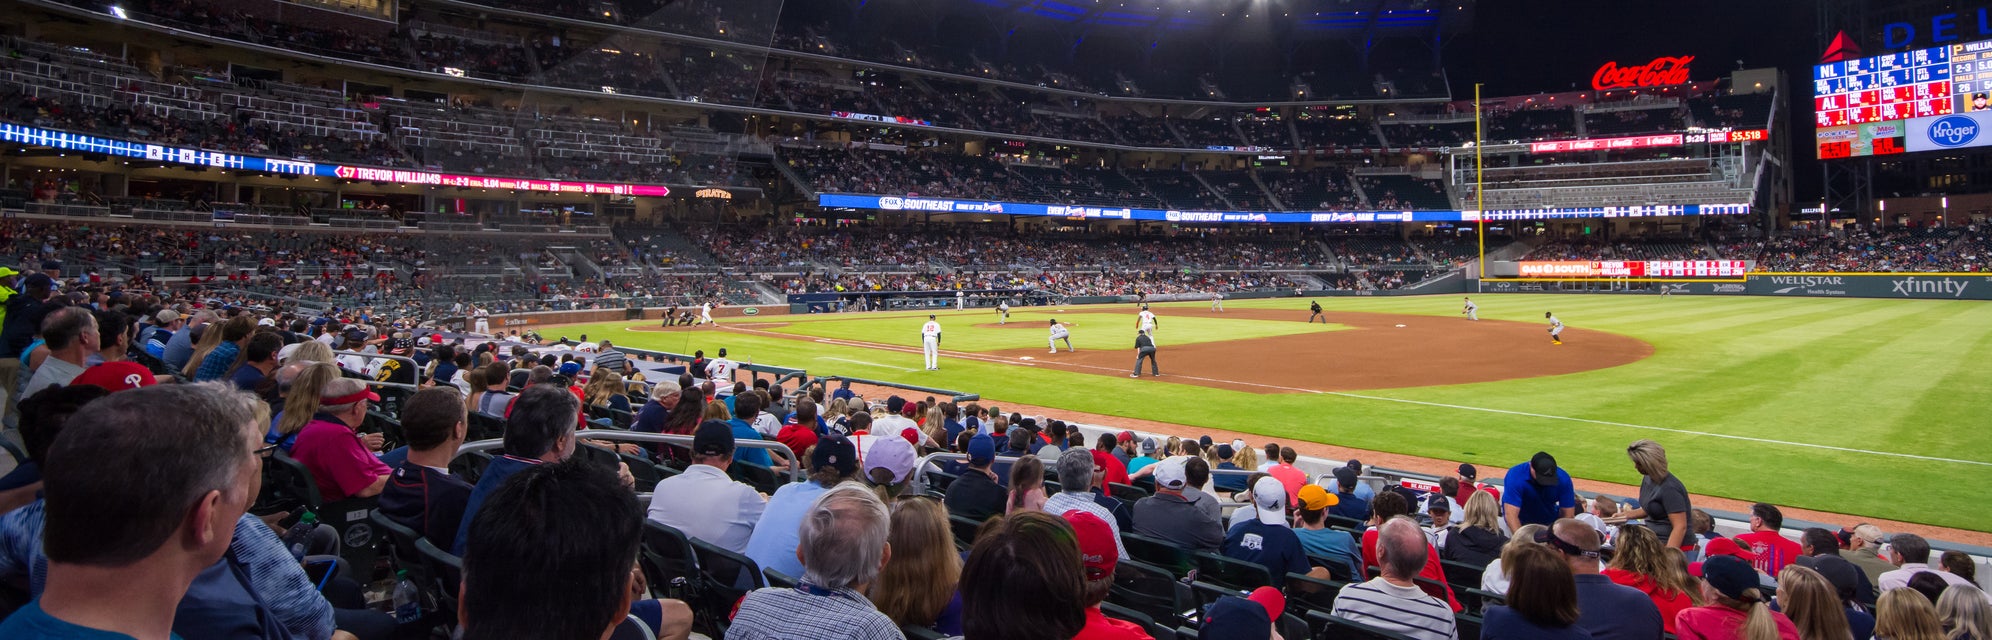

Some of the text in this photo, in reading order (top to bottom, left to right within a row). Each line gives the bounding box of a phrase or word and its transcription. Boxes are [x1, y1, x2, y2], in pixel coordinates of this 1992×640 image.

[1820, 64, 1837, 78] NL
[1956, 63, 1971, 73] 2-3
[1958, 84, 1970, 92] 26
[1822, 96, 1839, 110] AL
[1732, 131, 1761, 142] $5,518
[1933, 122, 1975, 143] Kroger
[1686, 135, 1705, 143] 9:26
[134, 144, 143, 158] 9
[152, 150, 158, 159] R
[185, 152, 190, 160] H
[271, 163, 277, 171] 2
[288, 165, 293, 173] 1
[303, 166, 310, 174] 0
[342, 167, 356, 178] 57
[357, 168, 393, 182] TREVOR
[395, 170, 441, 185] WILLIAMS
[456, 177, 468, 186] 2-3
[483, 179, 499, 188] 5.04
[696, 188, 732, 199] PIRATES
[904, 200, 954, 211] SOUTHEAST
[1048, 207, 1065, 215] EVERY
[1086, 208, 1101, 217] GAME
[1181, 212, 1223, 221] SOUTHEAST
[1311, 214, 1331, 222] EVERY
[1356, 213, 1374, 221] GAME
[1522, 265, 1542, 273] GAS
[1771, 276, 1843, 286] WELLSTAR
[1892, 276, 1968, 297] xfinity
[719, 365, 725, 374] 7
[124, 373, 142, 388] P
